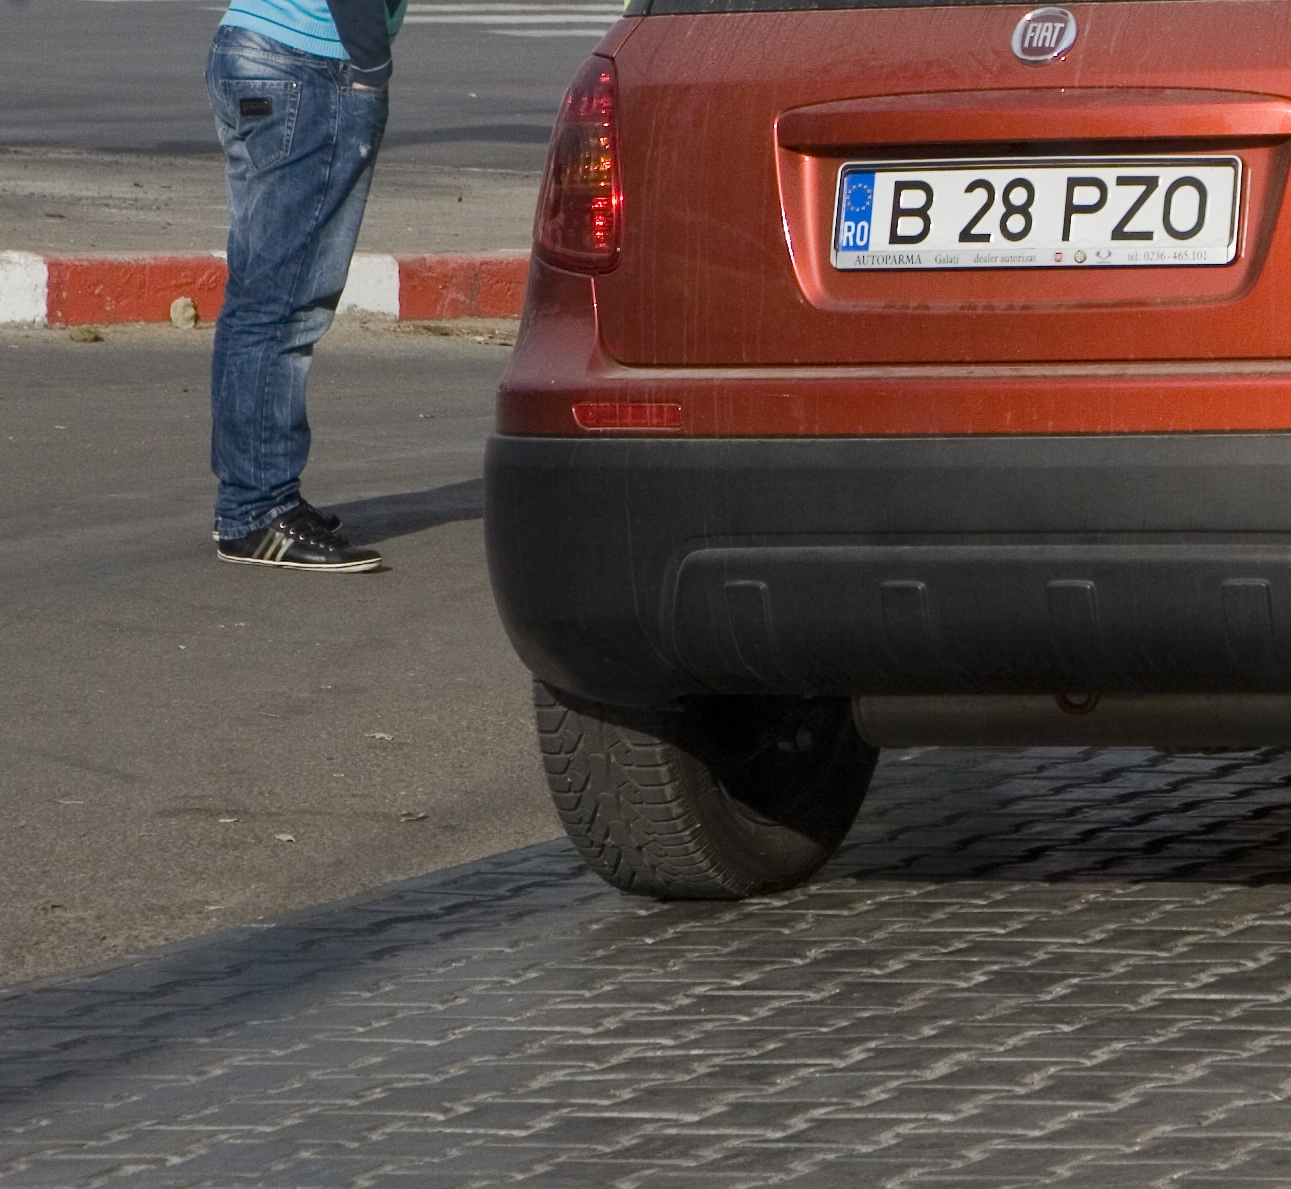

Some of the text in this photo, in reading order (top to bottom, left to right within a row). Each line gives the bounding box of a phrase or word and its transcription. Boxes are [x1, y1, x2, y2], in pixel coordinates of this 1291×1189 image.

[1023, 22, 1065, 48] FIAT
[888, 175, 1209, 245] B 28 PZO
[842, 220, 870, 246] RO
[854, 254, 922, 266] AUTOPARMA
[973, 253, 998, 264] dealer
[1000, 253, 1037, 264] autorizat
